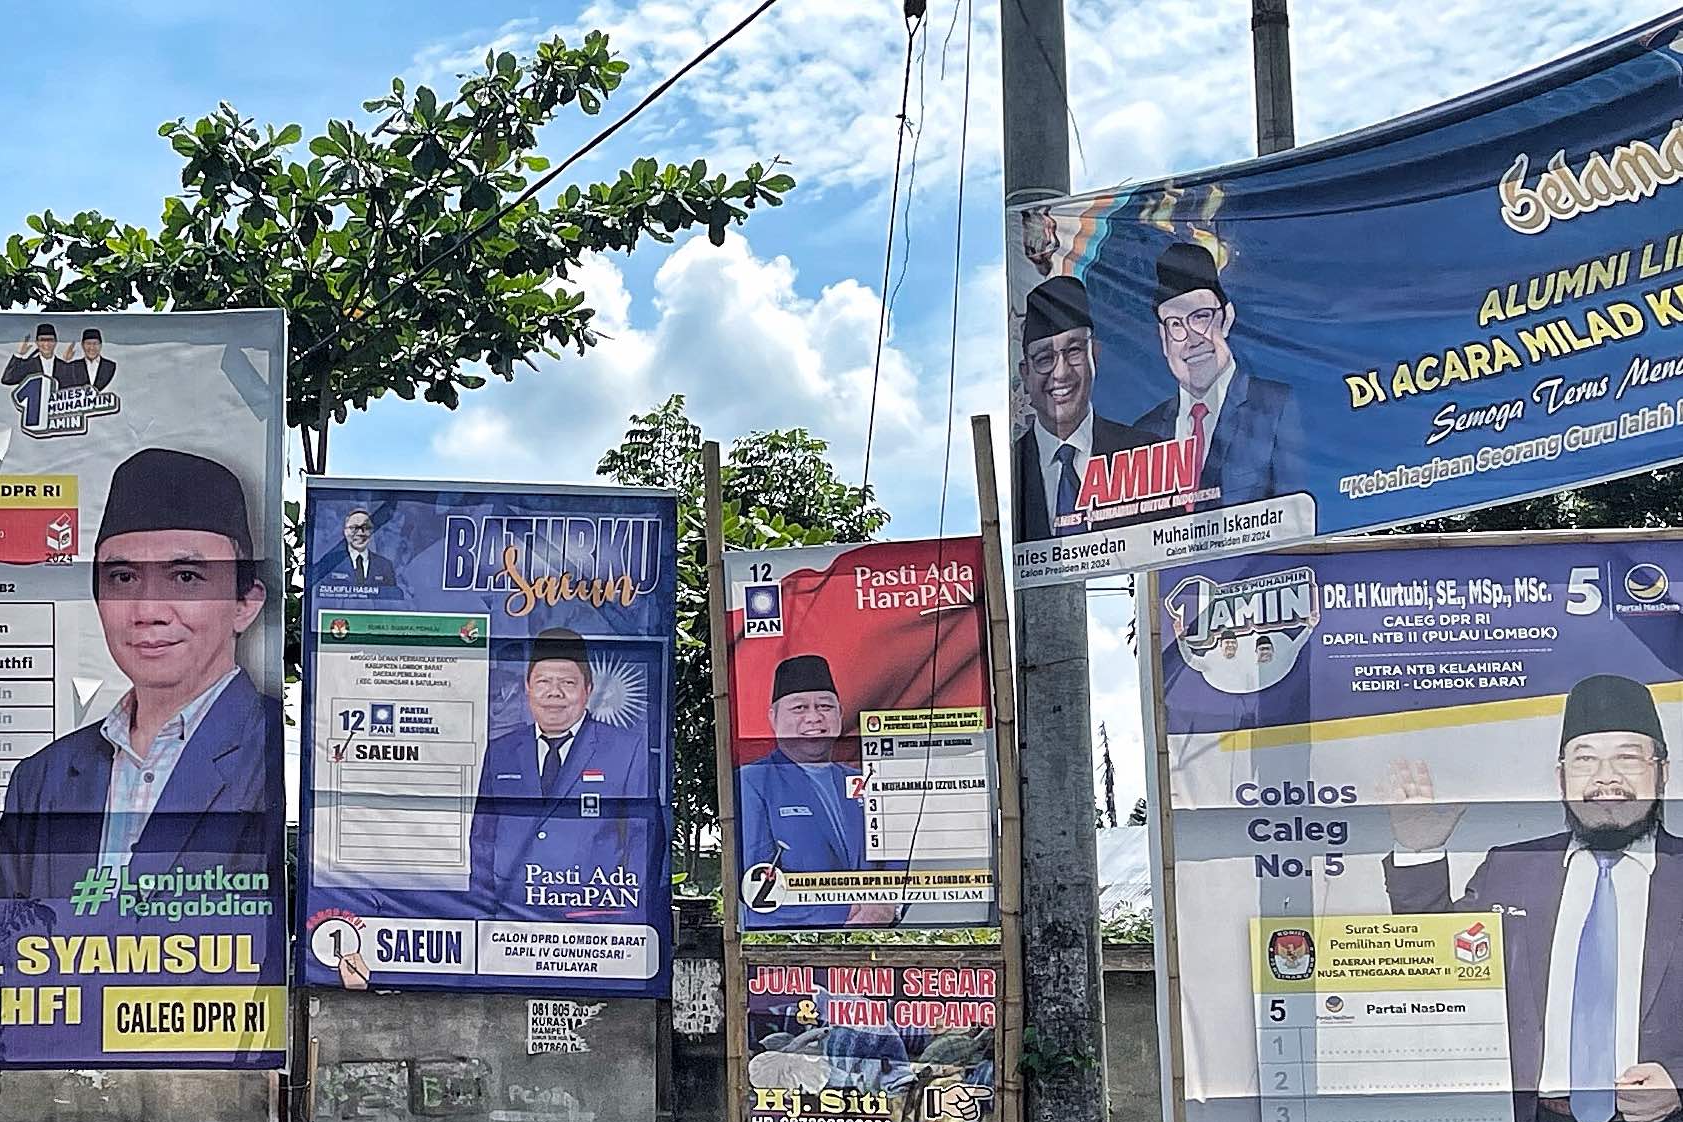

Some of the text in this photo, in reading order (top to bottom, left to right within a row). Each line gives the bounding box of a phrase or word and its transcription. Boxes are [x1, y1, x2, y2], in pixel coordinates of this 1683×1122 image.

[1478, 250, 1631, 327] ALUMNI
[1346, 371, 1387, 408] DI
[1392, 338, 1521, 398] ACARA
[1525, 303, 1645, 364] MILAD
[48, 395, 112, 413] MUHAIMIN
[1427, 399, 1525, 445] Semoga
[1533, 376, 1610, 416] Terus
[1077, 435, 1198, 509] AMIN
[1, 485, 36, 497] DPR
[43, 485, 61, 497] RI
[1153, 508, 1284, 546] Muhaimin Iskandar
[442, 515, 662, 594] BATURKU
[1052, 537, 1126, 561] Baswedan
[750, 563, 773, 582] 12
[854, 561, 974, 588] Pasti Ada
[856, 582, 975, 610] HaraPAN
[1565, 566, 1603, 616] 5
[1210, 583, 1311, 630] AMIN
[747, 619, 782, 633] PAN
[1383, 613, 1490, 628] CALEG DPR RI
[1322, 626, 1558, 645] DAPIL NTB II (PULAU LOMBOK)
[1354, 660, 1523, 677] PUTRA NTB KELAHIRAN
[1351, 675, 1527, 692] KEDIRI LOMBOK BARAT
[338, 710, 365, 732] 12
[371, 725, 394, 734] PAN
[355, 744, 419, 761] SAEUN
[1235, 780, 1358, 807] Coblos
[1247, 817, 1349, 845] Caleg
[525, 864, 638, 887] Pasti Ada
[1254, 852, 1345, 878] No. 5
[525, 886, 641, 908] HaraPAN
[750, 866, 777, 909] 2
[120, 893, 273, 922] Pengabdian
[491, 933, 646, 946] CALON DPRD LOMBOK BARAT
[1345, 923, 1419, 934] Surat Suara
[17, 934, 261, 976] SYAMSUL
[377, 928, 463, 965] SAEUN
[504, 947, 625, 959] DAPIL IV GUNUNGSARI
[1330, 937, 1436, 950] Pemilihan Umum
[535, 961, 598, 972] BATULAYAR
[1332, 956, 1435, 967] DAERAH PEMILIHAN
[749, 966, 997, 998] JUAL IKAN SEGAR
[117, 1002, 265, 1034] CALEG DPR RI
[532, 1003, 570, 1016] 081 805
[796, 1000, 997, 1029] & IKAN CUPANG
[1270, 999, 1466, 1022] 5 Partai NasDem
[531, 1017, 566, 1026] KURAS
[753, 1086, 891, 1118] Hj. Siti
